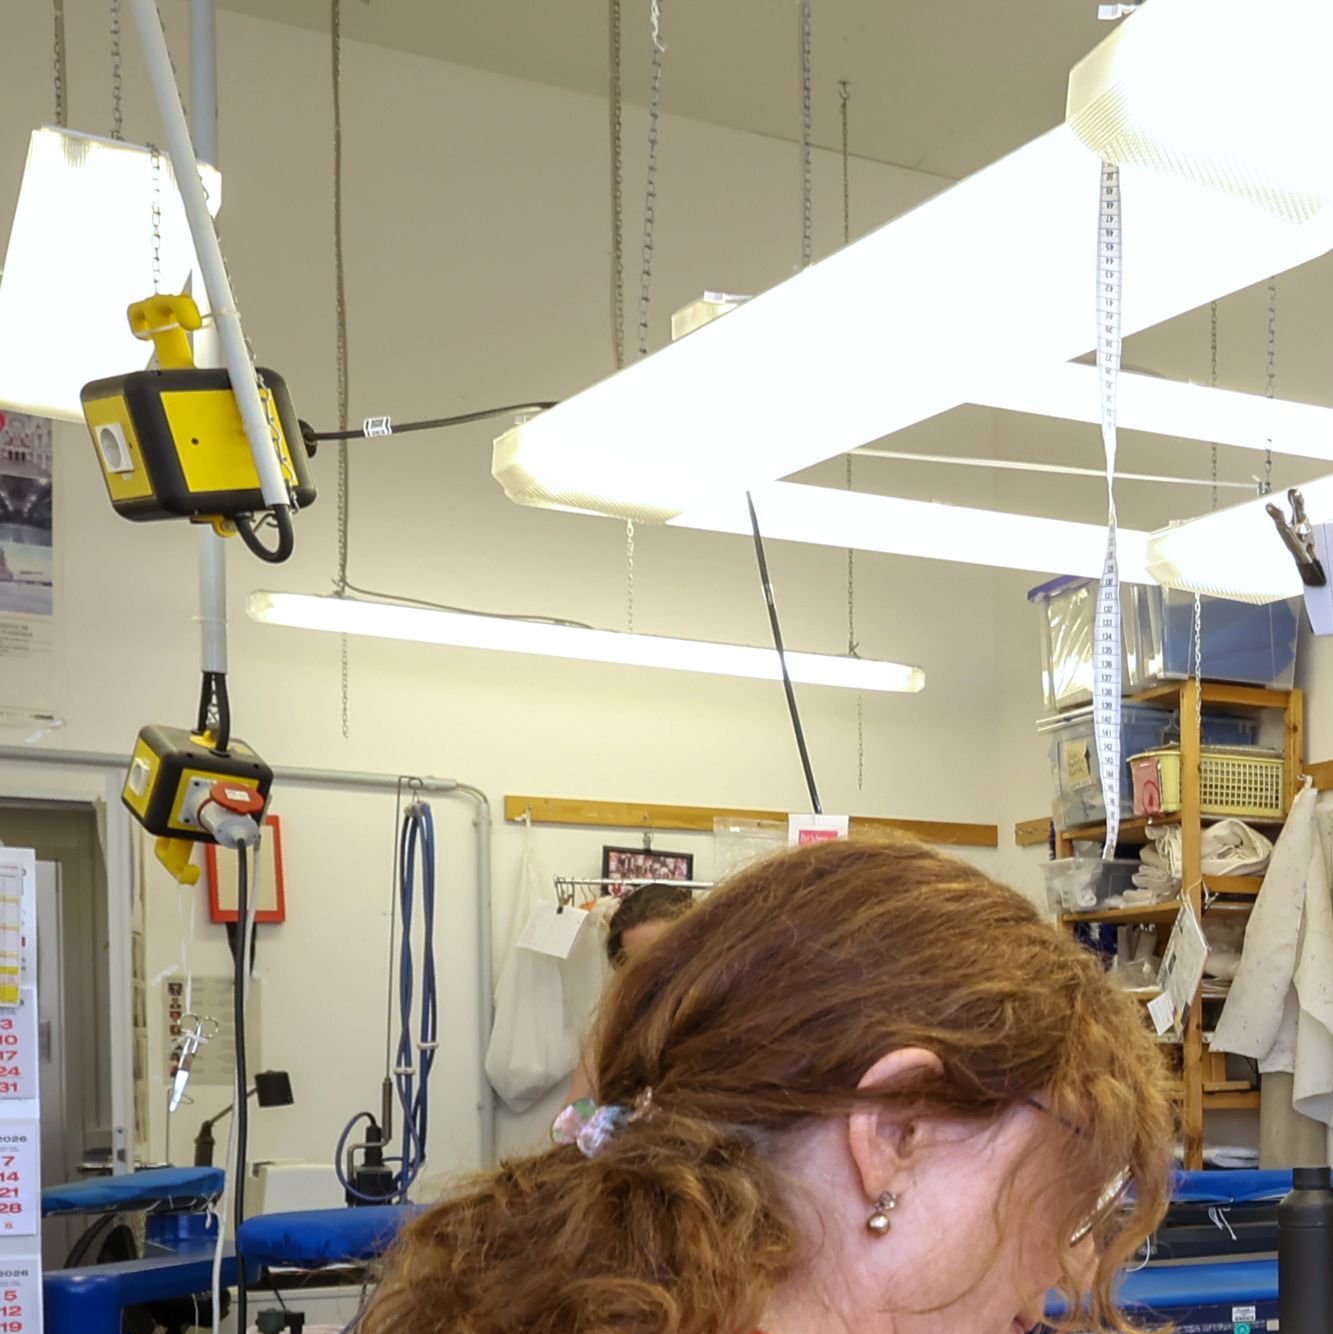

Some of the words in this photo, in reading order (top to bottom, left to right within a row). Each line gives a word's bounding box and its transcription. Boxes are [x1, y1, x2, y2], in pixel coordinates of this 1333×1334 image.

[1104, 604, 1113, 613] 132
[1102, 619, 1113, 627] 133
[1102, 632, 1112, 641] 134
[1101, 646, 1113, 655] 135
[1101, 660, 1113, 669] 136
[1101, 674, 1113, 682] 137
[1101, 688, 1113, 697] 138
[1101, 701, 1113, 710] 139
[1101, 715, 1112, 724] 140
[1102, 729, 1112, 737] 141
[1103, 743, 1113, 752] 142
[0, 1019, 13, 1030] 3
[0, 1034, 18, 1045] 10
[0, 1050, 18, 1061] 17
[0, 1066, 21, 1077] 24
[0, 1082, 18, 1092] 31
[2, 1156, 15, 1167] 7
[0, 1172, 20, 1182] 14
[0, 1187, 20, 1198] 21
[0, 1203, 23, 1214] 28
[4, 1290, 17, 1301] 5
[0, 1306, 22, 1317] 12
[0, 1322, 22, 1332] 19
